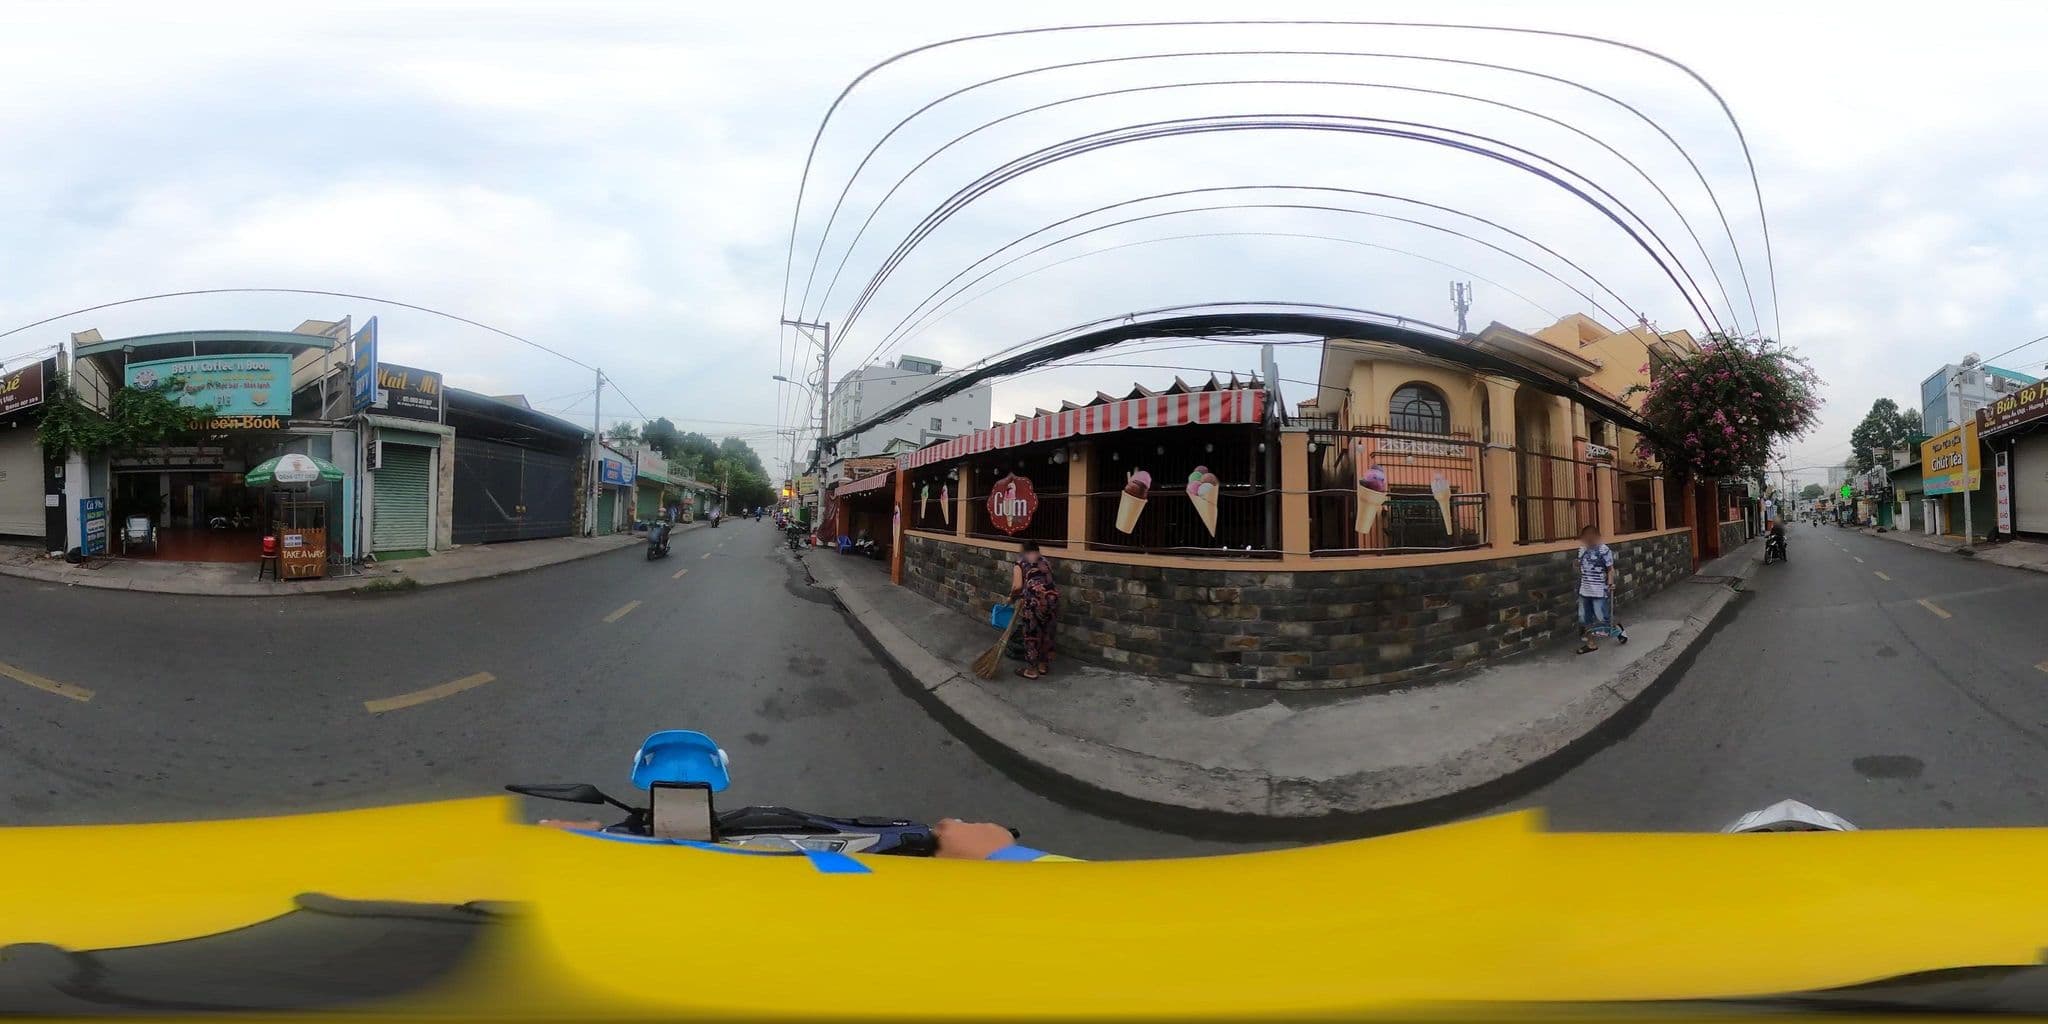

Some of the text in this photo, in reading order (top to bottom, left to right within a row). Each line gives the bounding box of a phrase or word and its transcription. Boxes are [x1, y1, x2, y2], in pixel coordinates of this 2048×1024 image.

[200, 361, 233, 372] Coffee
[246, 360, 271, 371] Book
[1996, 397, 2018, 415] Bún
[2020, 387, 2036, 405] Bò
[243, 415, 281, 429] Book
[994, 491, 1027, 517] Gum
[281, 550, 302, 559] TAKE
